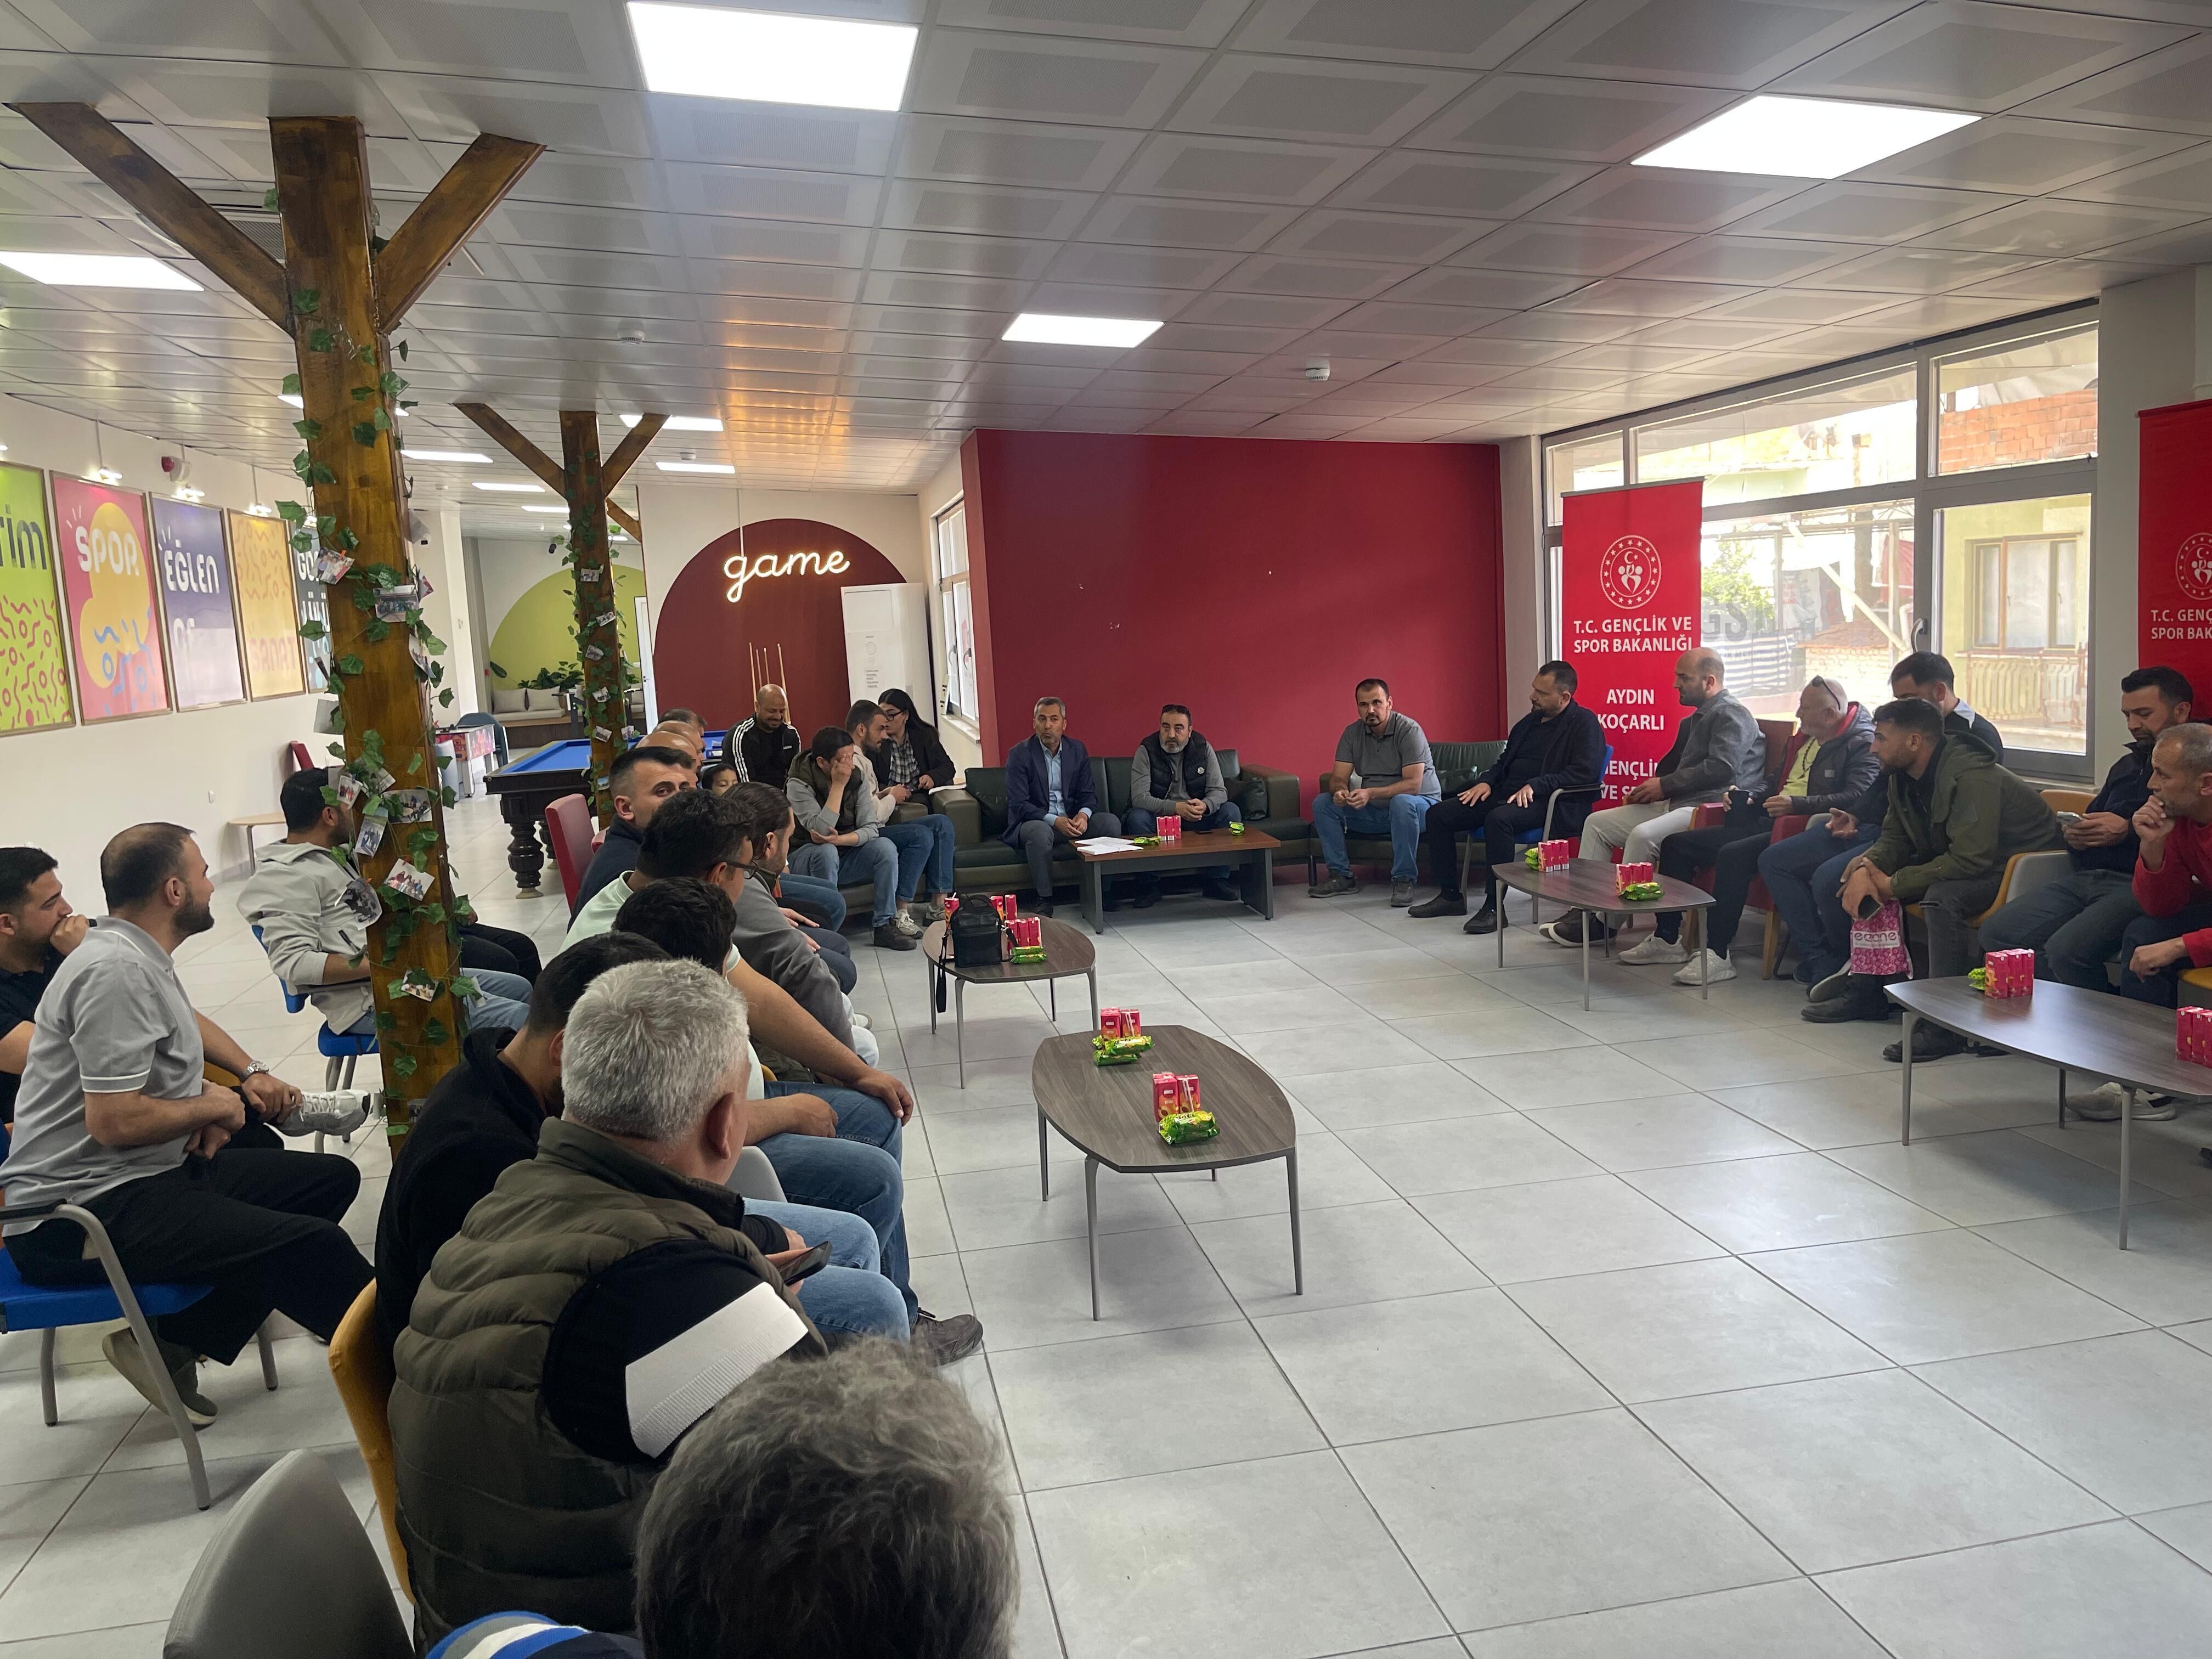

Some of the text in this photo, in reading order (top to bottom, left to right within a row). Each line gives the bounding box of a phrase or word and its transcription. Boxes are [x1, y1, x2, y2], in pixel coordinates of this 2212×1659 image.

[76, 526, 139, 576] SPOR
[724, 551, 851, 603] game
[1573, 614, 1692, 635] T.C. GENÇLİK VE
[2151, 610, 2174, 622] T.C.
[2151, 627, 2184, 640] SPOR
[1574, 634, 1692, 653] SPOR BAKANLIĞI
[1606, 689, 1655, 704] AYDIN
[1597, 714, 1664, 733] KOÇARLI
[1605, 759, 1658, 780] ENÇLİ
[1601, 785, 1618, 800] VE
